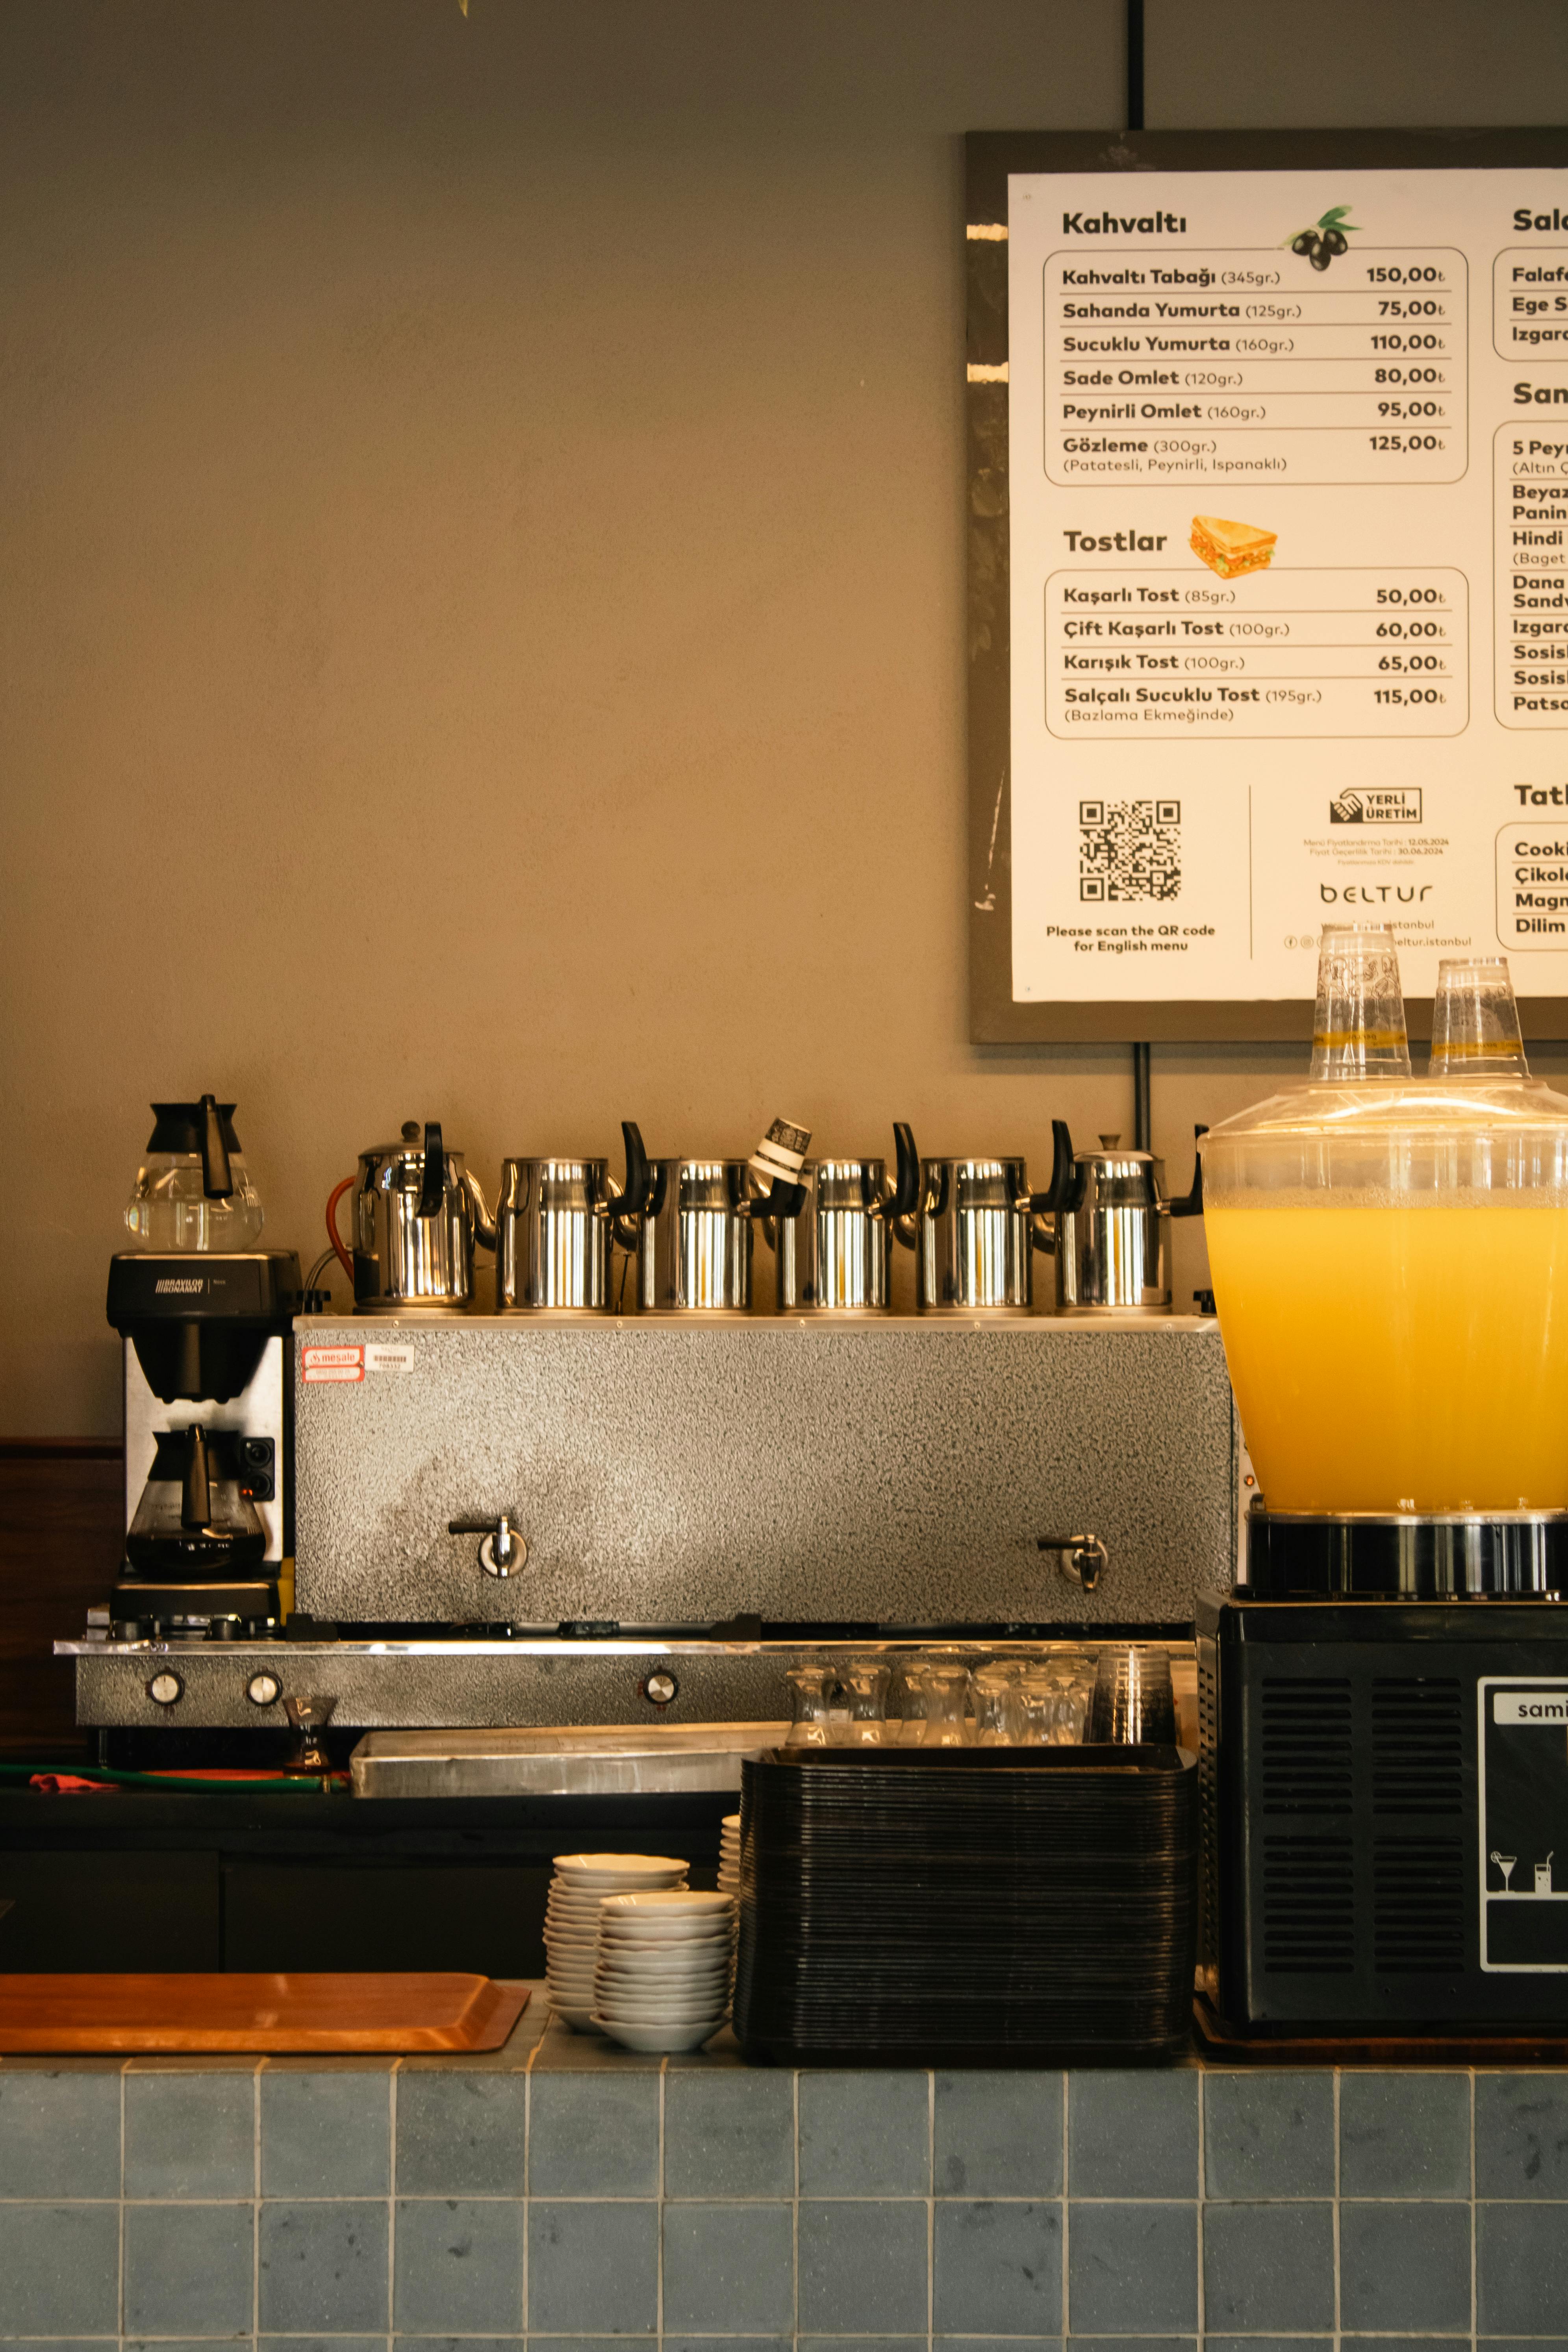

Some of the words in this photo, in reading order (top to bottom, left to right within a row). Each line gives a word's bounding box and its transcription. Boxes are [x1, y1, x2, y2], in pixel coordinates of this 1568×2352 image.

[1063, 211, 1186, 234] Kahvaltı
[1063, 269, 1145, 285] Kahvaltı
[1150, 268, 1216, 287] Tabağı
[1221, 271, 1281, 286] (345gr.)
[1063, 302, 1150, 318] Sahanda
[1155, 303, 1240, 317] Yumurta
[1246, 305, 1302, 320] (125gr.)
[1512, 297, 1549, 315] Ege
[1063, 336, 1140, 352] Sucuklu
[1145, 337, 1230, 351] Yumurta
[1235, 339, 1294, 354] (160gr.)
[1064, 370, 1113, 386] Sade
[1118, 370, 1179, 385] Omlet
[1184, 373, 1243, 387] (120gr.)
[1063, 404, 1136, 423] Peynirli
[1140, 403, 1202, 418] Omlet
[1207, 406, 1266, 421] (160gr.)
[1063, 437, 1148, 452] Gözleme
[1153, 440, 1217, 455] (300gr.)
[1513, 441, 1524, 455] 5
[1529, 440, 1568, 459] Pey
[1063, 459, 1142, 473] (Patatesli,
[1148, 458, 1207, 473] Peynirli,
[1213, 458, 1287, 473] Ispanaklı)
[1512, 462, 1555, 475] (Altın
[1063, 530, 1168, 552] Tostlar
[1513, 530, 1562, 545] Hindi
[1513, 552, 1565, 567] (Baget
[1513, 575, 1564, 589] Dana
[1064, 588, 1132, 605] Kaşarlı
[1136, 588, 1179, 602] Tost
[1185, 590, 1236, 605] (85gr.)
[1514, 593, 1568, 608] Sand
[1064, 621, 1103, 639] Çift
[1108, 621, 1176, 638] Kaşarlı
[1181, 621, 1224, 635] Tost
[1229, 623, 1290, 638] (100gr.)
[1064, 654, 1131, 672] Karışık
[1136, 654, 1179, 669] Tost
[1184, 657, 1245, 671] (100gr.)
[1514, 670, 1568, 685] Sosis
[1065, 688, 1130, 705] Salçalı
[1136, 687, 1212, 702] Sucuklu
[1217, 688, 1260, 702] Tost
[1265, 690, 1322, 704] (195gr.)
[1064, 709, 1138, 723] (Bazlama
[1144, 708, 1234, 723] Ekmeğinde)
[1367, 793, 1405, 805] YERLİ
[1366, 807, 1417, 819] ÜRETİM
[1047, 926, 1092, 936] Please
[1131, 925, 1154, 936] the
[1158, 925, 1179, 936] QR
[1182, 925, 1215, 936] code
[1516, 918, 1565, 932] Dilim
[1074, 941, 1094, 951] for
[1097, 940, 1147, 954] English
